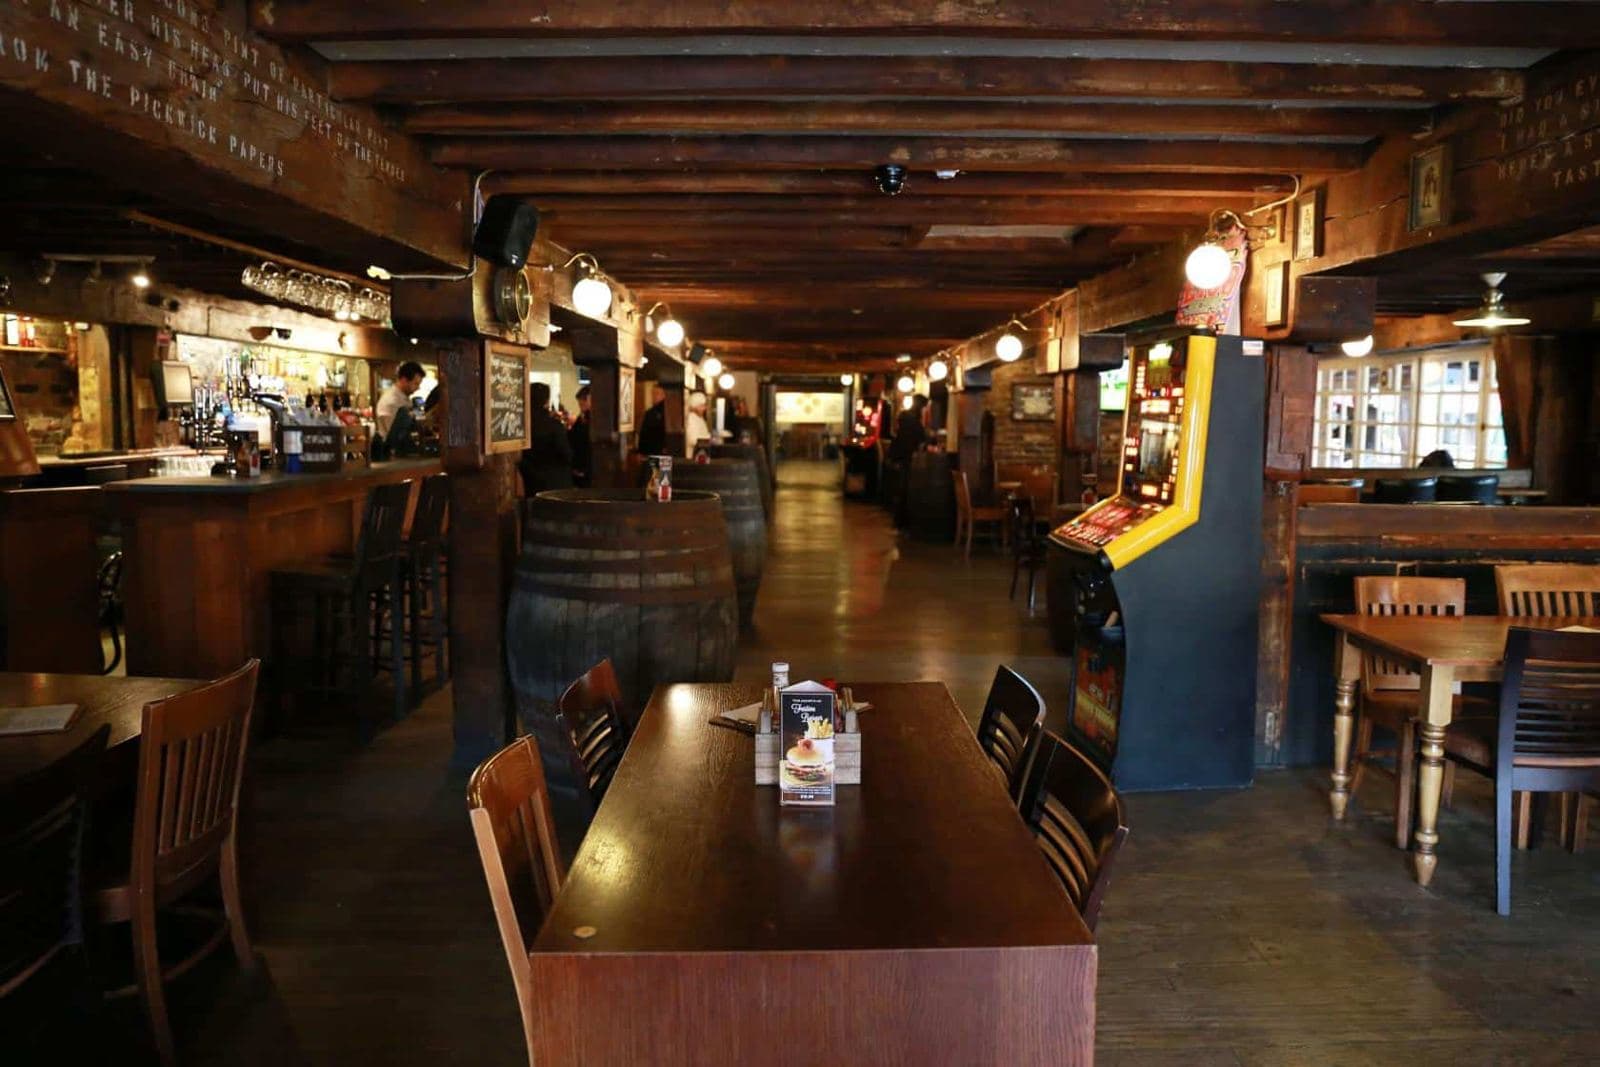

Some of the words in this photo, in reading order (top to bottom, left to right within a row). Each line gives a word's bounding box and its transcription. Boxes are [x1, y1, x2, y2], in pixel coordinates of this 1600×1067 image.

[98, 22, 152, 69] EASY
[151, 14, 181, 49] HIS
[243, 71, 270, 102] PUT
[276, 91, 299, 120] HIS
[68, 58, 112, 99] THE
[129, 85, 217, 145] PICKWICK
[228, 134, 285, 177] PAPERS
